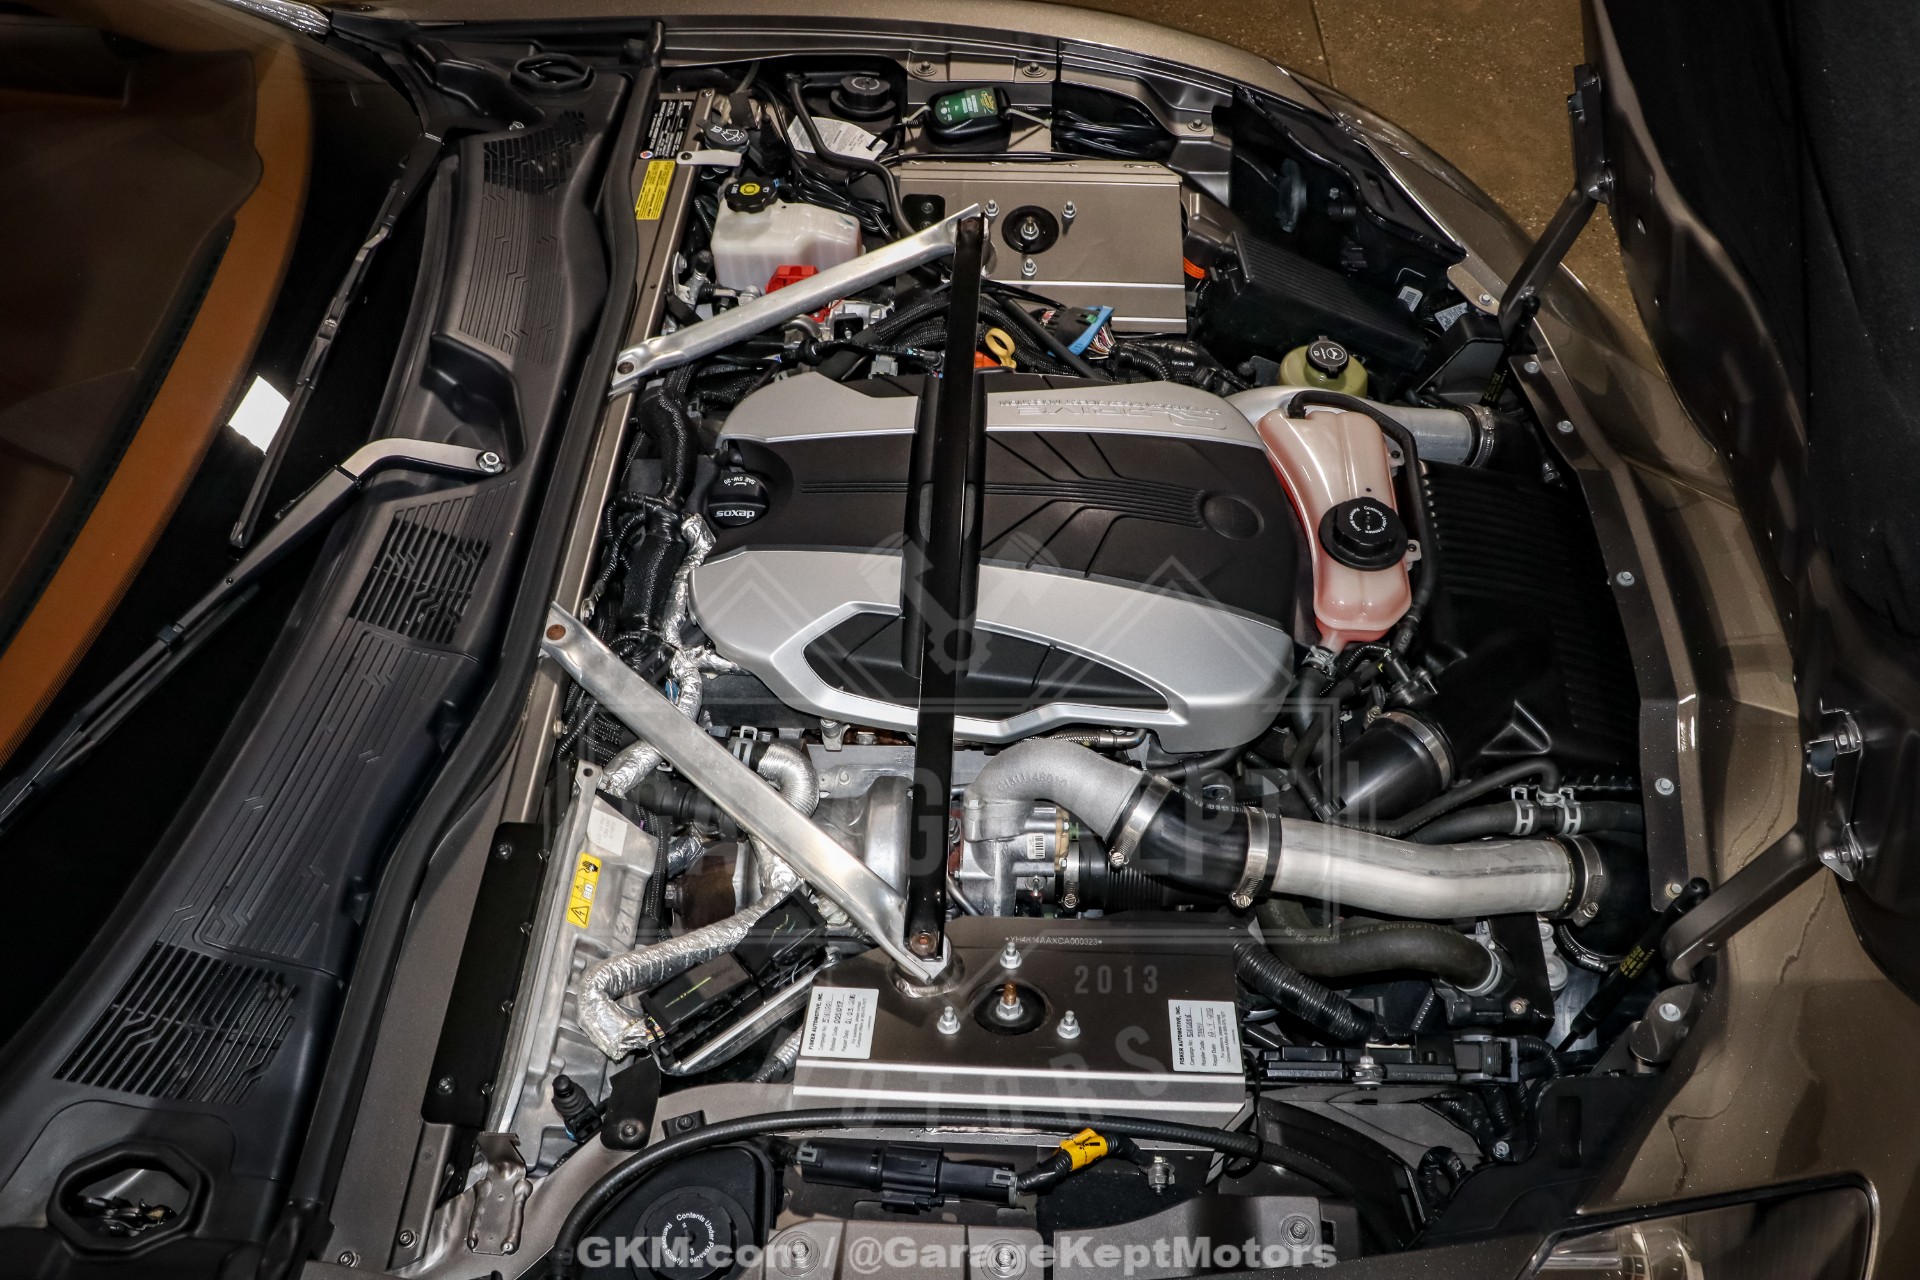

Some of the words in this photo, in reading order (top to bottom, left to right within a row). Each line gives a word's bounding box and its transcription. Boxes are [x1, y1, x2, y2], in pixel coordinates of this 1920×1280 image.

[714, 509, 756, 519] dexos
[676, 1212, 706, 1223] Contents
[660, 1222, 673, 1251] Remove
[703, 1220, 716, 1242] Under
[665, 1248, 684, 1266] Slowly
[689, 1241, 715, 1264] Pressure
